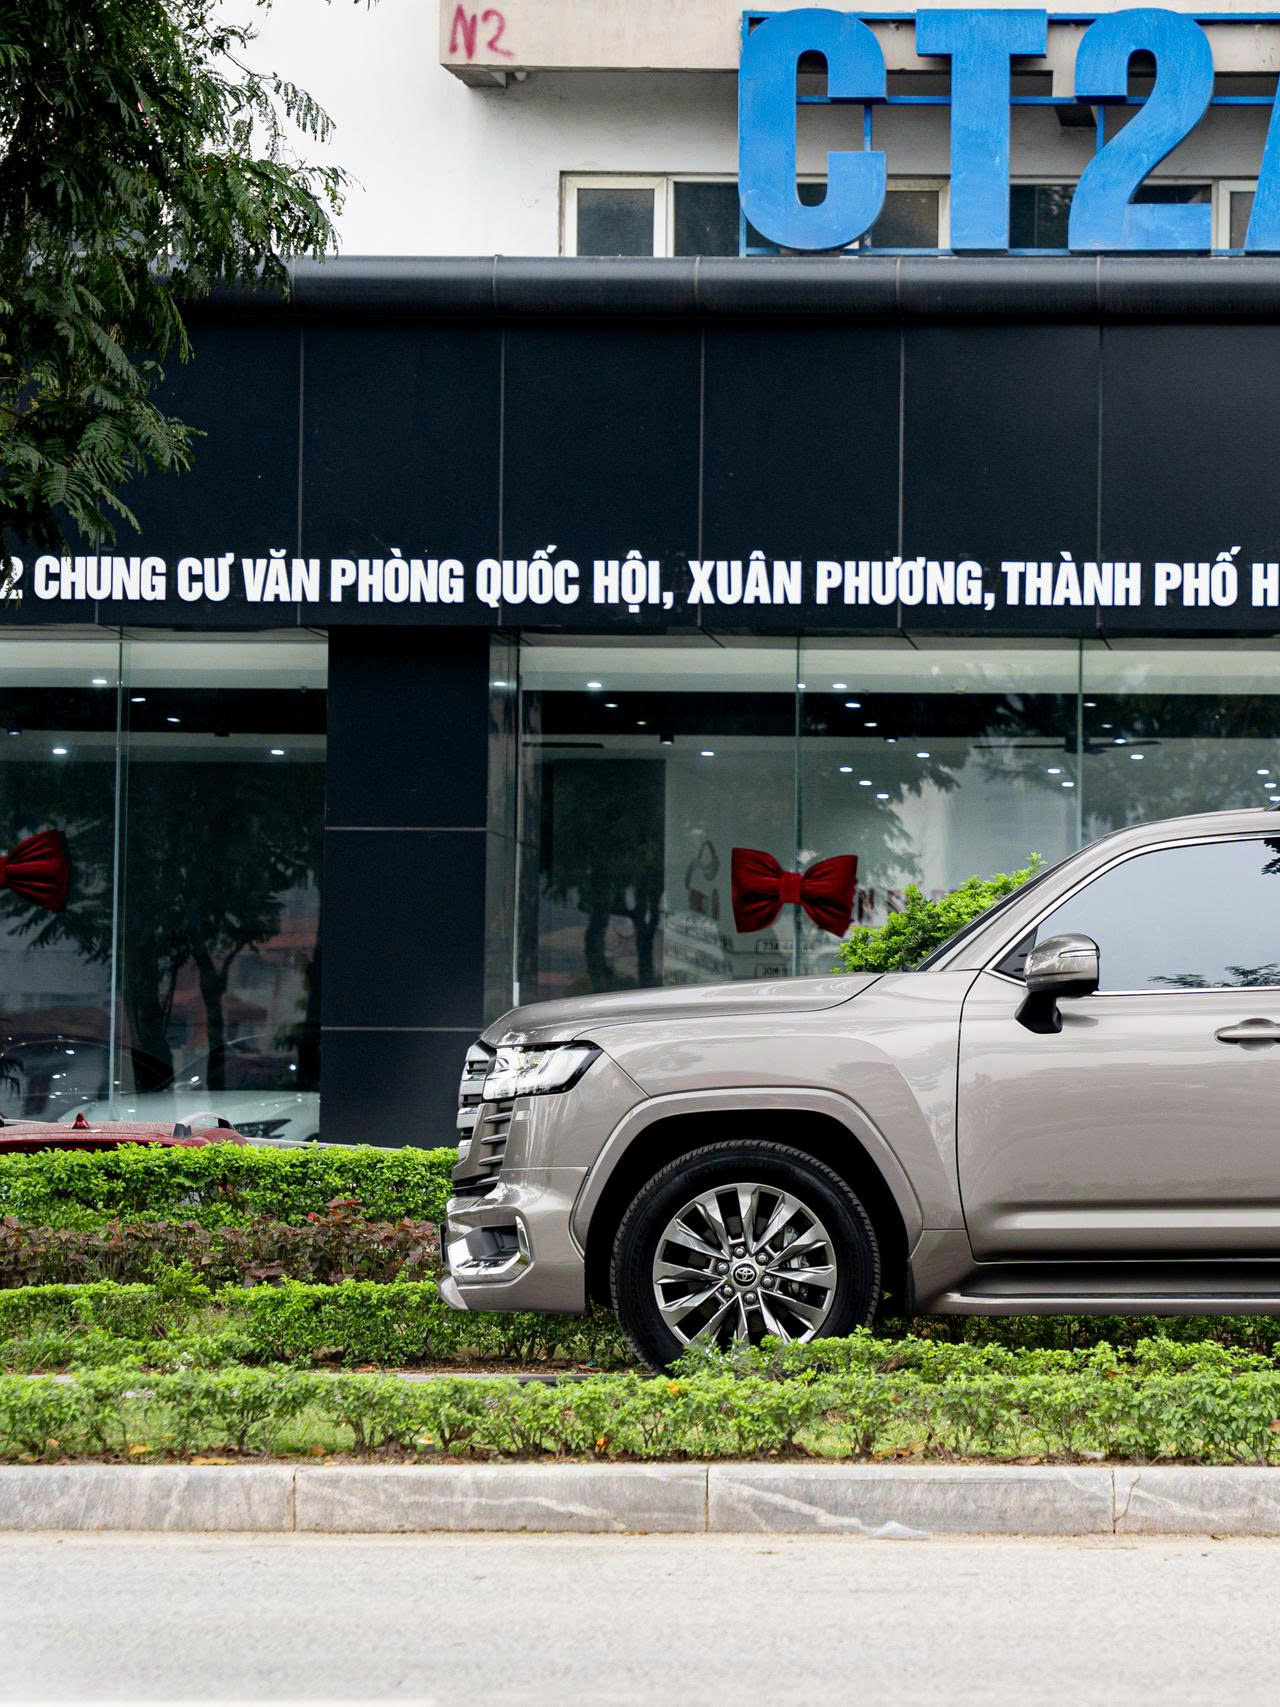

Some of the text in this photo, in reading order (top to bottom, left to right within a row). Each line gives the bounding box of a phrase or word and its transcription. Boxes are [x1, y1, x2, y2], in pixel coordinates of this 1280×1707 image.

[449, 3, 515, 60] N2
[34, 555, 167, 601] CHUNG
[177, 552, 235, 602] CƯ
[241, 548, 320, 602] VĂN
[330, 547, 464, 604] PHÒNG
[476, 544, 580, 608] QUỐC
[593, 549, 674, 613] HỘI,
[686, 550, 802, 605] XUÂN
[816, 556, 995, 611] PHƯƠNG,
[1001, 551, 1141, 606] THÀNH
[1154, 546, 1242, 607] PHỐ
